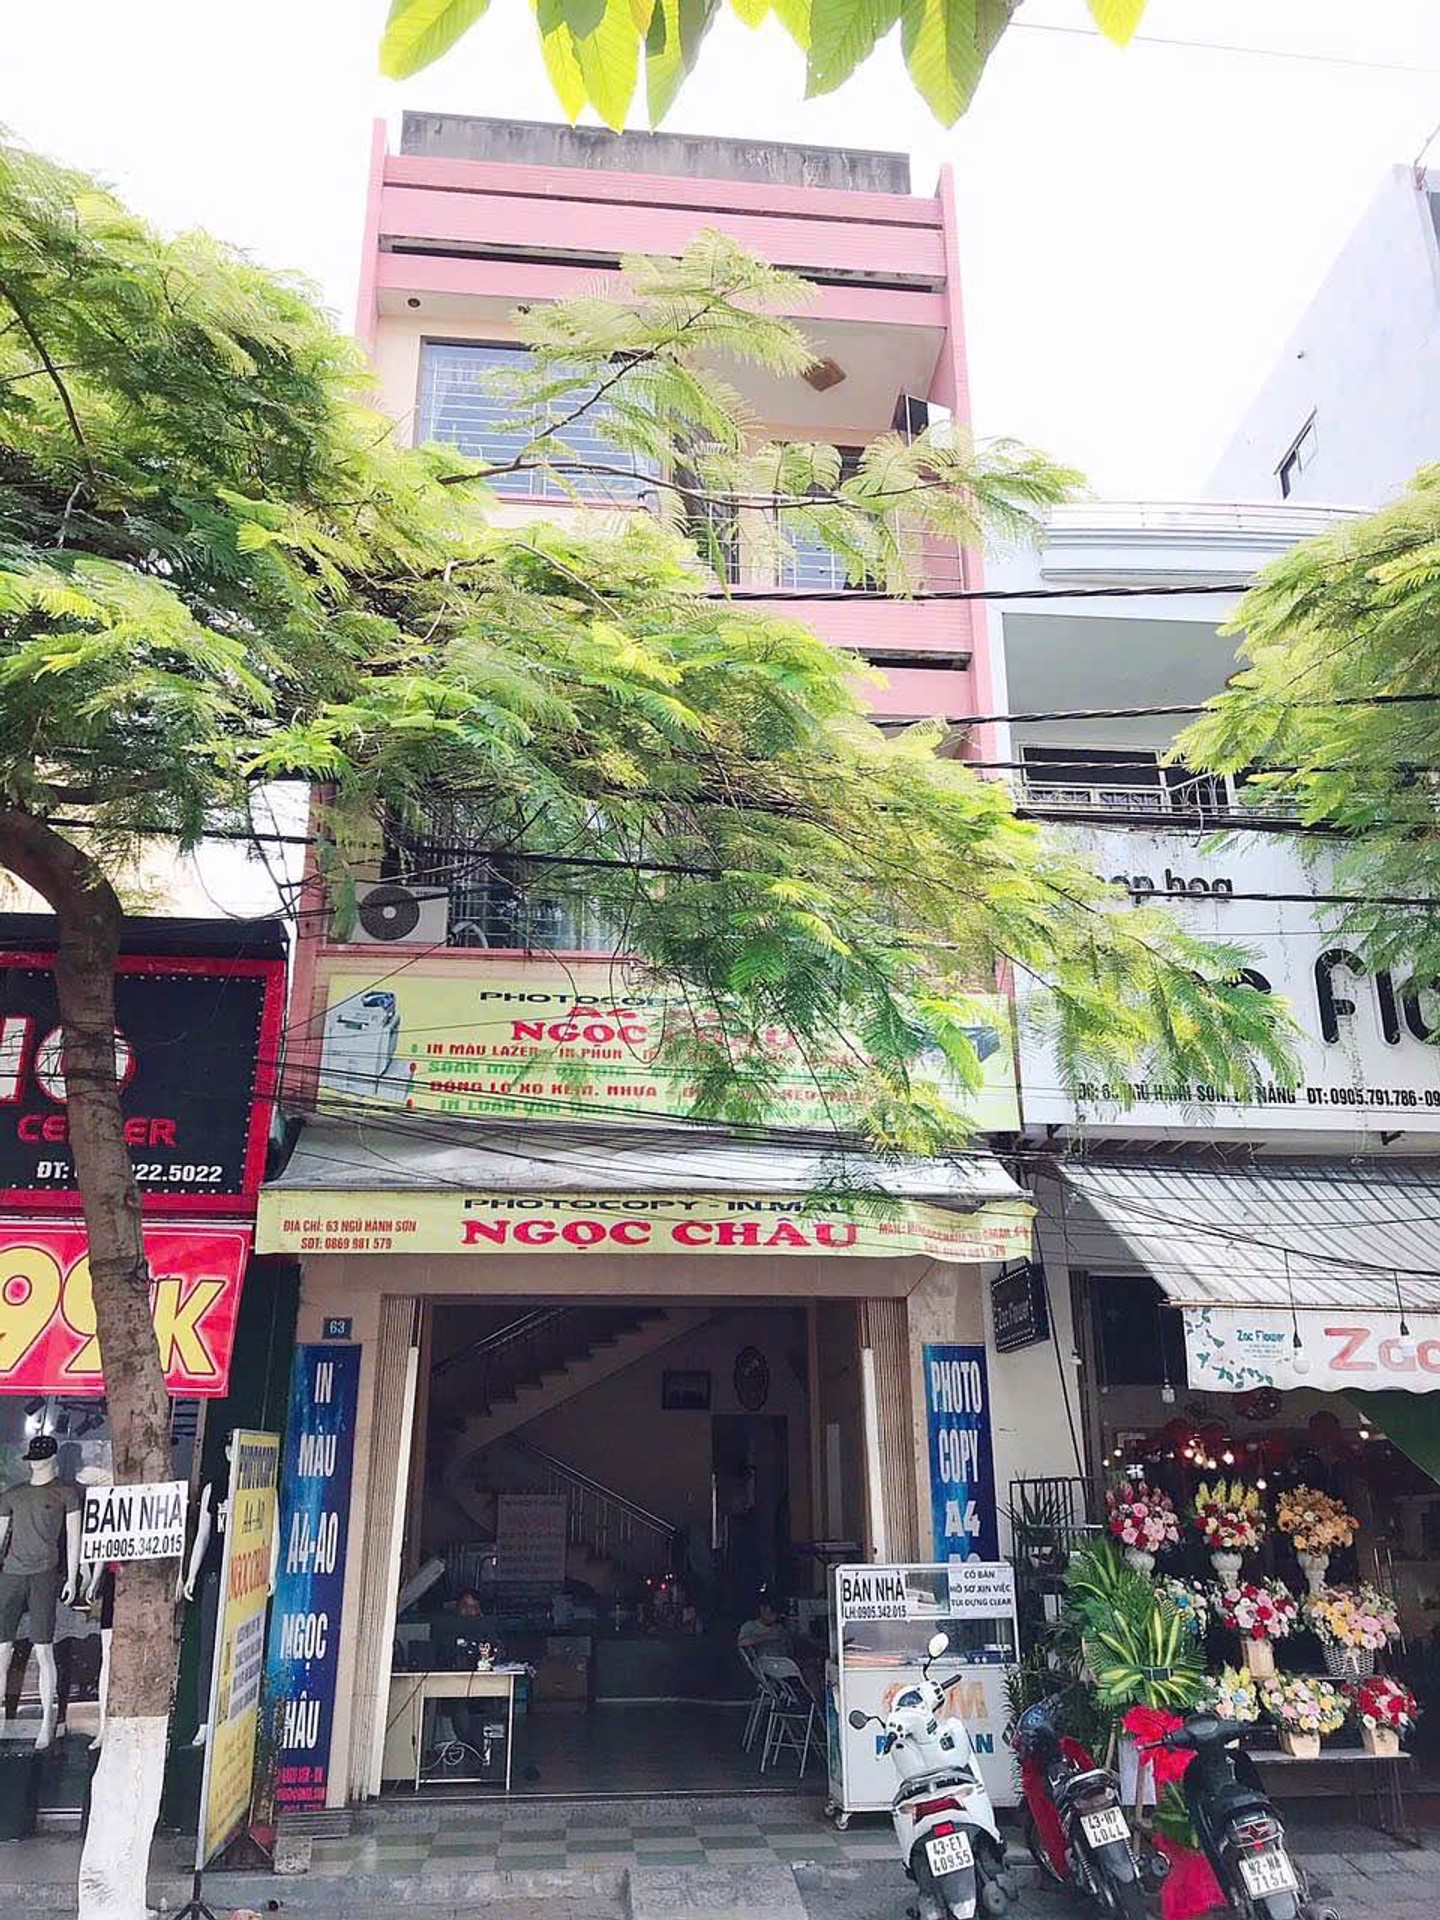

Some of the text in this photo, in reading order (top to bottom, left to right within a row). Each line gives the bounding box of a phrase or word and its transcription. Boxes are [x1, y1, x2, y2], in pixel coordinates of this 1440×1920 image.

[510, 1020, 648, 1047] NGỌC
[18, 1114, 178, 1148] CEER
[37, 1161, 69, 1179] ĐT:
[464, 1199, 697, 1210] PHOTOCOPY
[326, 1220, 339, 1231] 63
[460, 1217, 859, 1250] NGỌC CHÂU
[352, 1237, 370, 1249] 981
[329, 1320, 345, 1334] 63
[314, 1362, 333, 1403] IN
[930, 1360, 983, 1414] PHOTO
[298, 1427, 336, 1477] MÀU
[938, 1429, 979, 1483] COPY
[84, 1488, 133, 1534] BÁN
[139, 1483, 183, 1531] NHÀ
[945, 1499, 981, 1538] A4
[84, 1534, 183, 1559] LH:0905.342.015
[843, 1570, 905, 1602] BÁN NHÀ
[281, 1613, 328, 1670] NGỌC
[279, 1690, 321, 1749] HÂU
